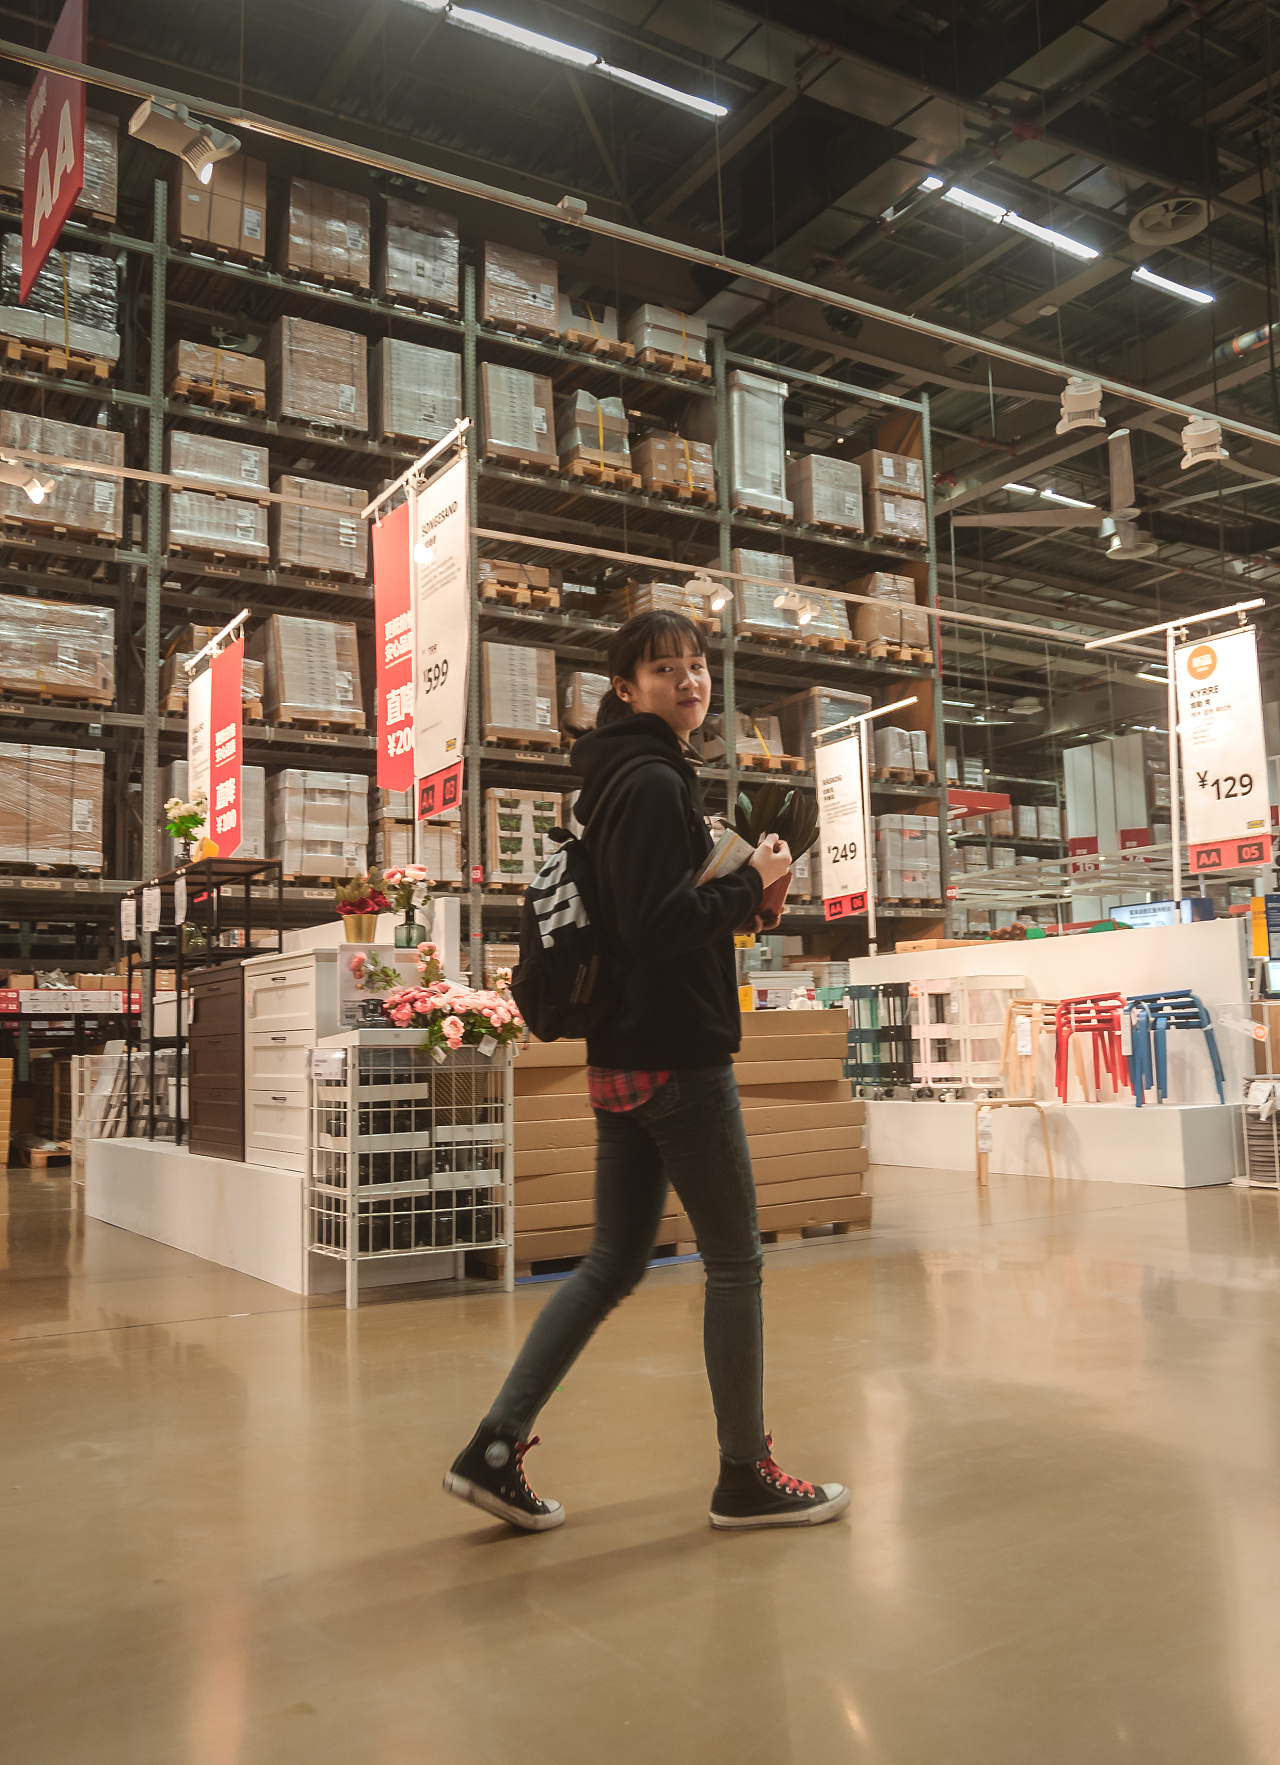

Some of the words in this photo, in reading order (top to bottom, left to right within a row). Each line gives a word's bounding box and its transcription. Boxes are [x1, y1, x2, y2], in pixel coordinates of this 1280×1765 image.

[31, 98, 75, 248] AA
[1190, 684, 1219, 698] KYRRE
[1196, 770, 1253, 800] ¥129
[1199, 851, 1220, 866] AA
[1241, 845, 1260, 860] 05
